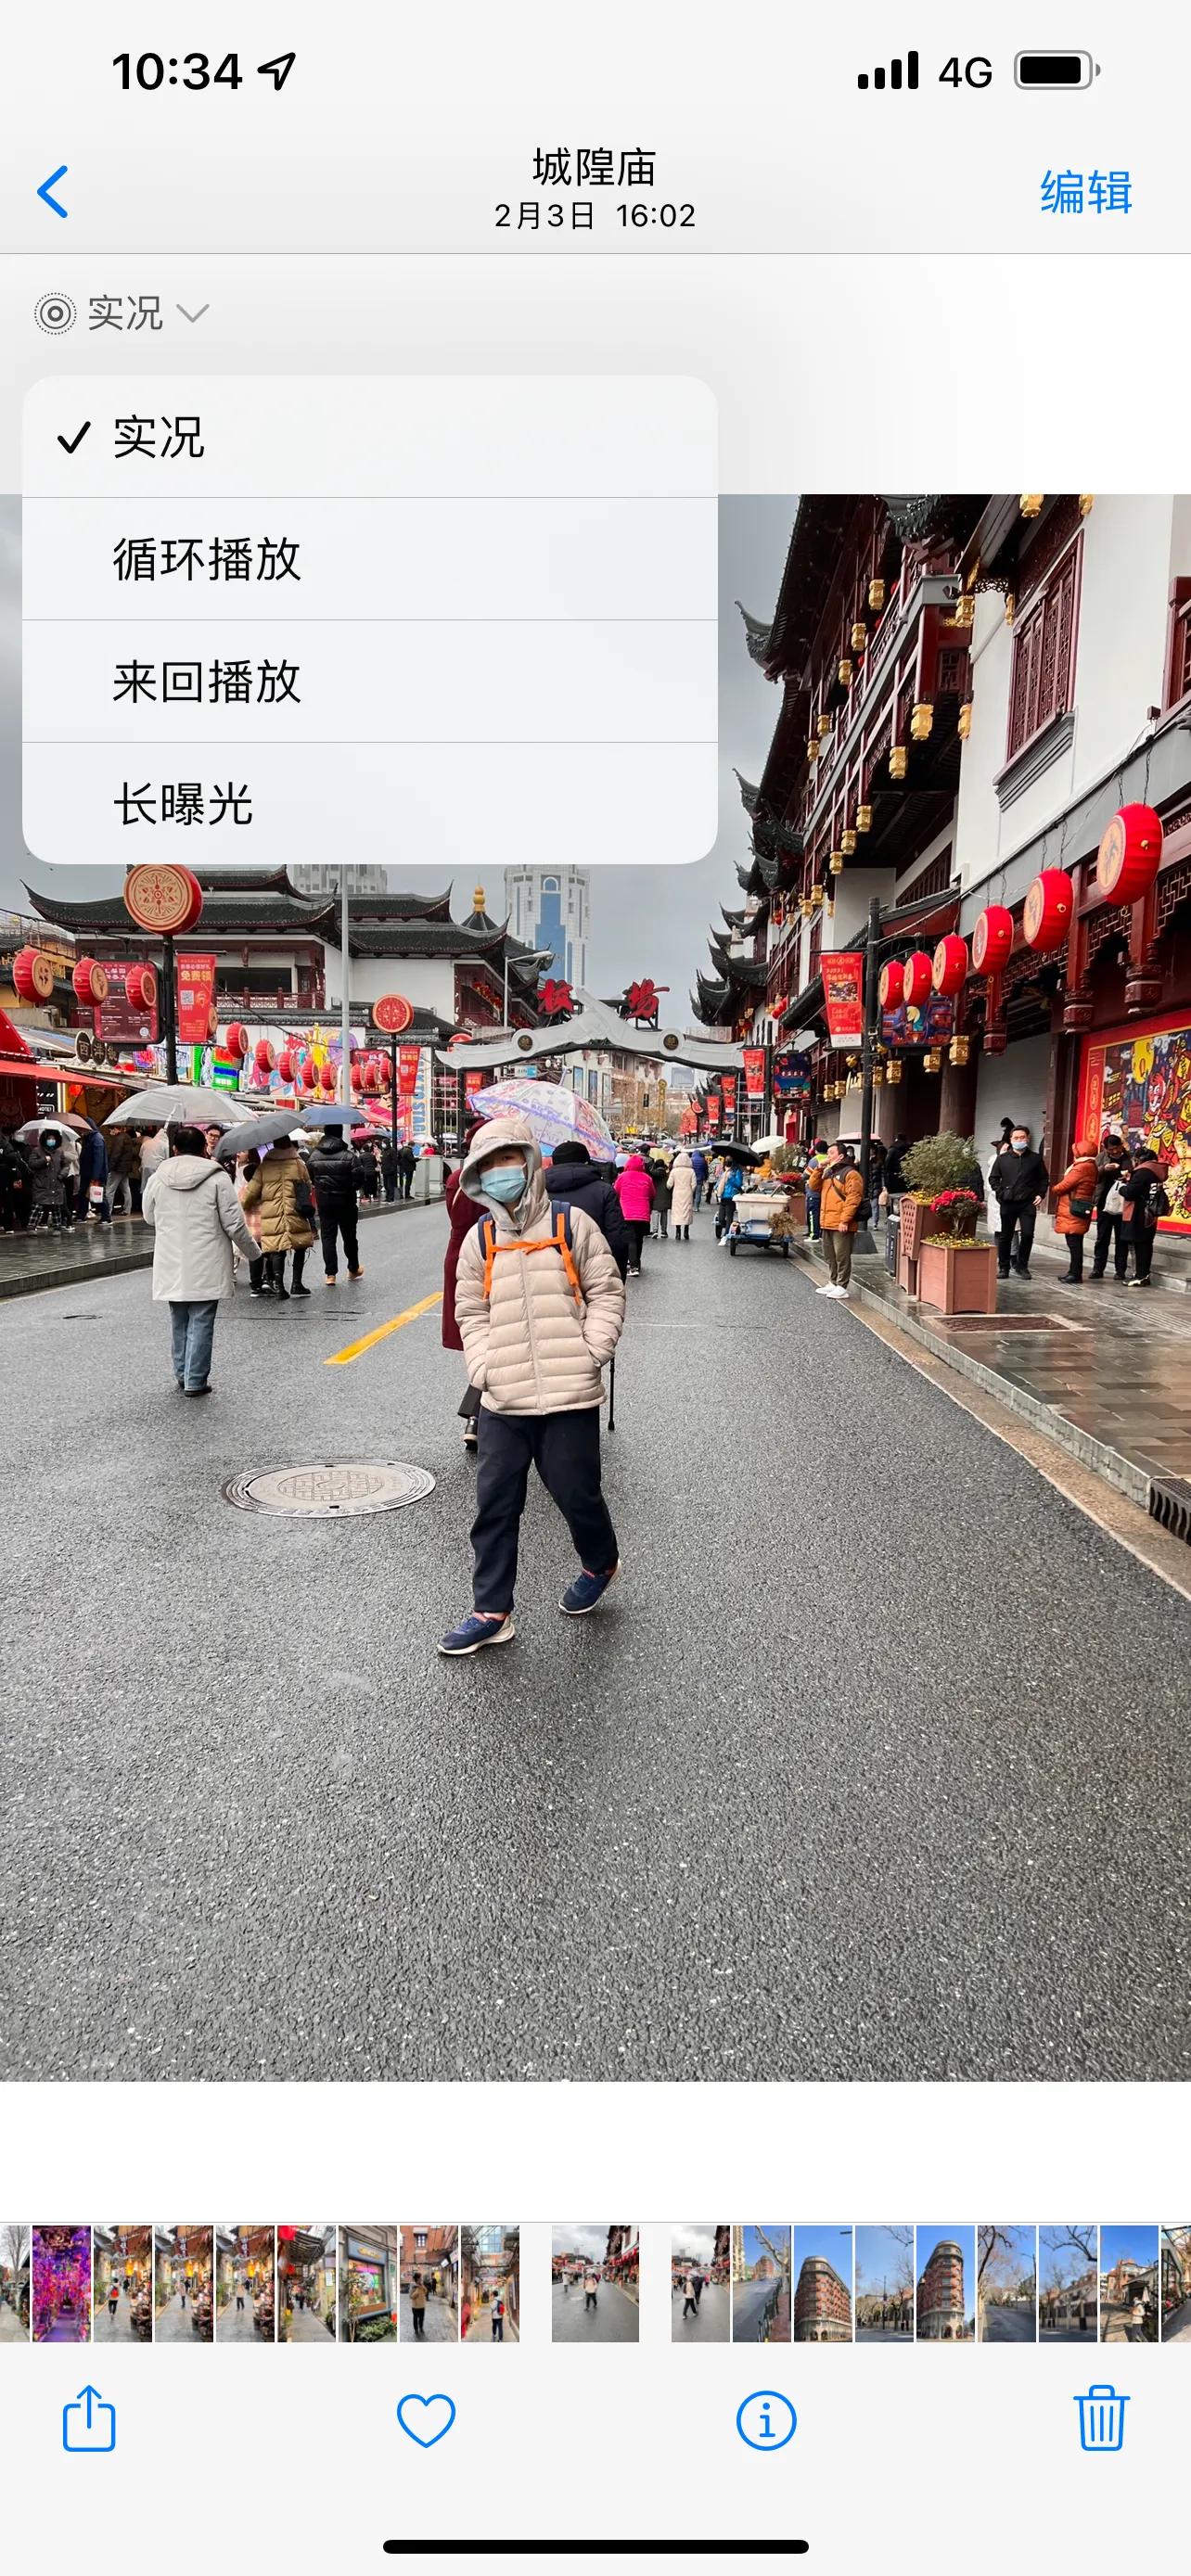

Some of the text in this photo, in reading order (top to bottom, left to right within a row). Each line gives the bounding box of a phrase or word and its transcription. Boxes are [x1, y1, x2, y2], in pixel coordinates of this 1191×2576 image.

[112, 52, 244, 91] 10:34
[938, 56, 992, 89] 4G
[531, 147, 657, 188] 城隍庙
[1040, 169, 1133, 214] 编辑
[494, 201, 696, 231] 2月3日 16:02
[88, 293, 163, 331] 实况
[114, 414, 205, 459] 实况
[112, 536, 301, 582] 循环播放
[112, 658, 301, 705] 来回播放
[113, 781, 253, 826] 长曝光
